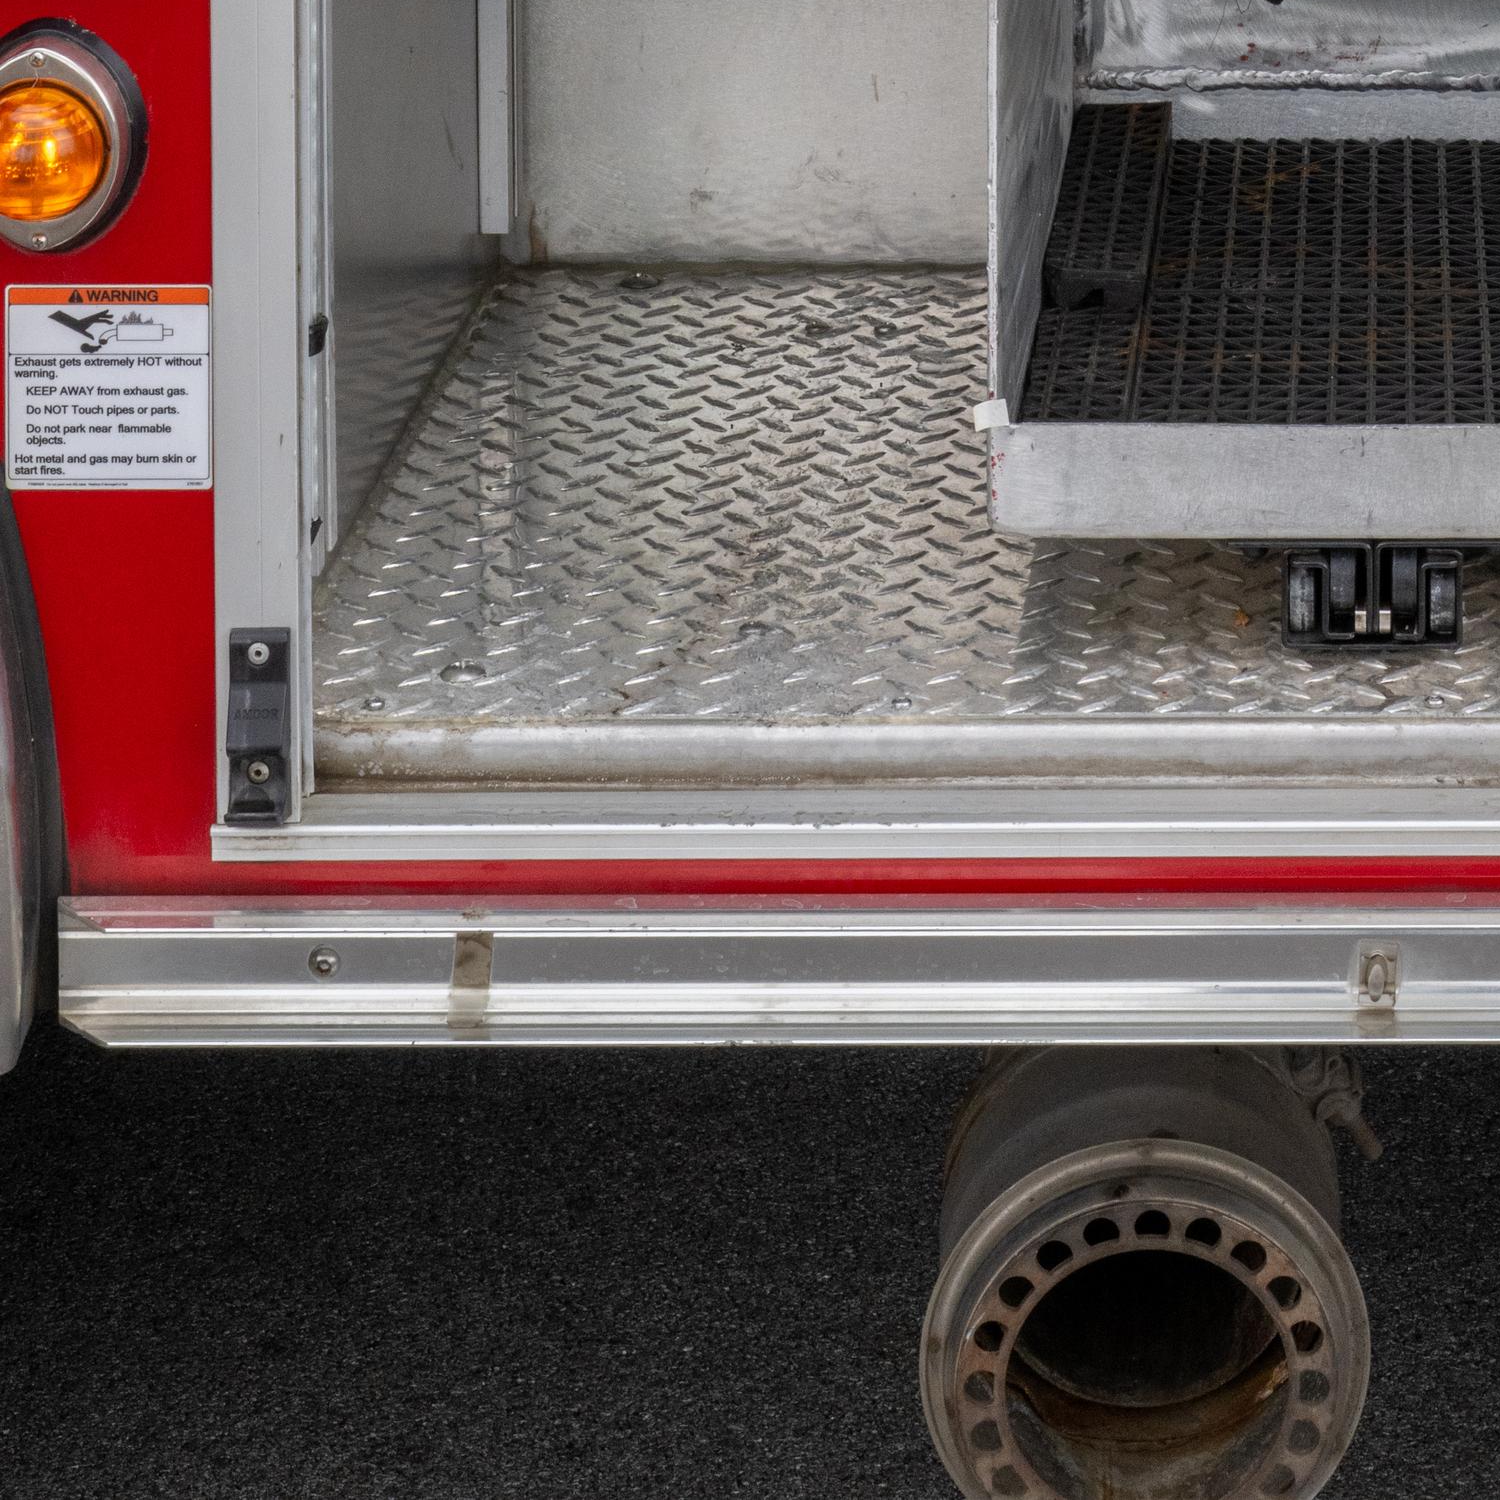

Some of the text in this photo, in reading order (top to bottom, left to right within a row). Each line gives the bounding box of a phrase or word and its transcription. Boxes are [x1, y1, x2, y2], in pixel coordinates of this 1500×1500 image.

[87, 290, 158, 302] WARNING
[15, 357, 202, 368] Exhaust gets extremely HOT without
[14, 370, 58, 379] warning.
[26, 386, 188, 397] KEEP AWAY from exhaust gas.
[26, 405, 41, 414] Do
[44, 405, 68, 414] NOT
[72, 405, 104, 414] Touch
[107, 405, 134, 416] pipes
[151, 406, 179, 416] parts.
[26, 424, 41, 433] Do
[44, 425, 60, 433] not
[63, 424, 86, 435] park
[118, 424, 171, 433] flammable
[26, 435, 66, 446] objects.
[15, 454, 33, 463] Hot
[36, 454, 64, 464] metal
[67, 454, 86, 463] and
[90, 456, 108, 466] gas
[111, 456, 133, 466] may
[136, 454, 159, 463] burn
[162, 454, 182, 463] skin
[15, 465, 64, 475] start fires.
